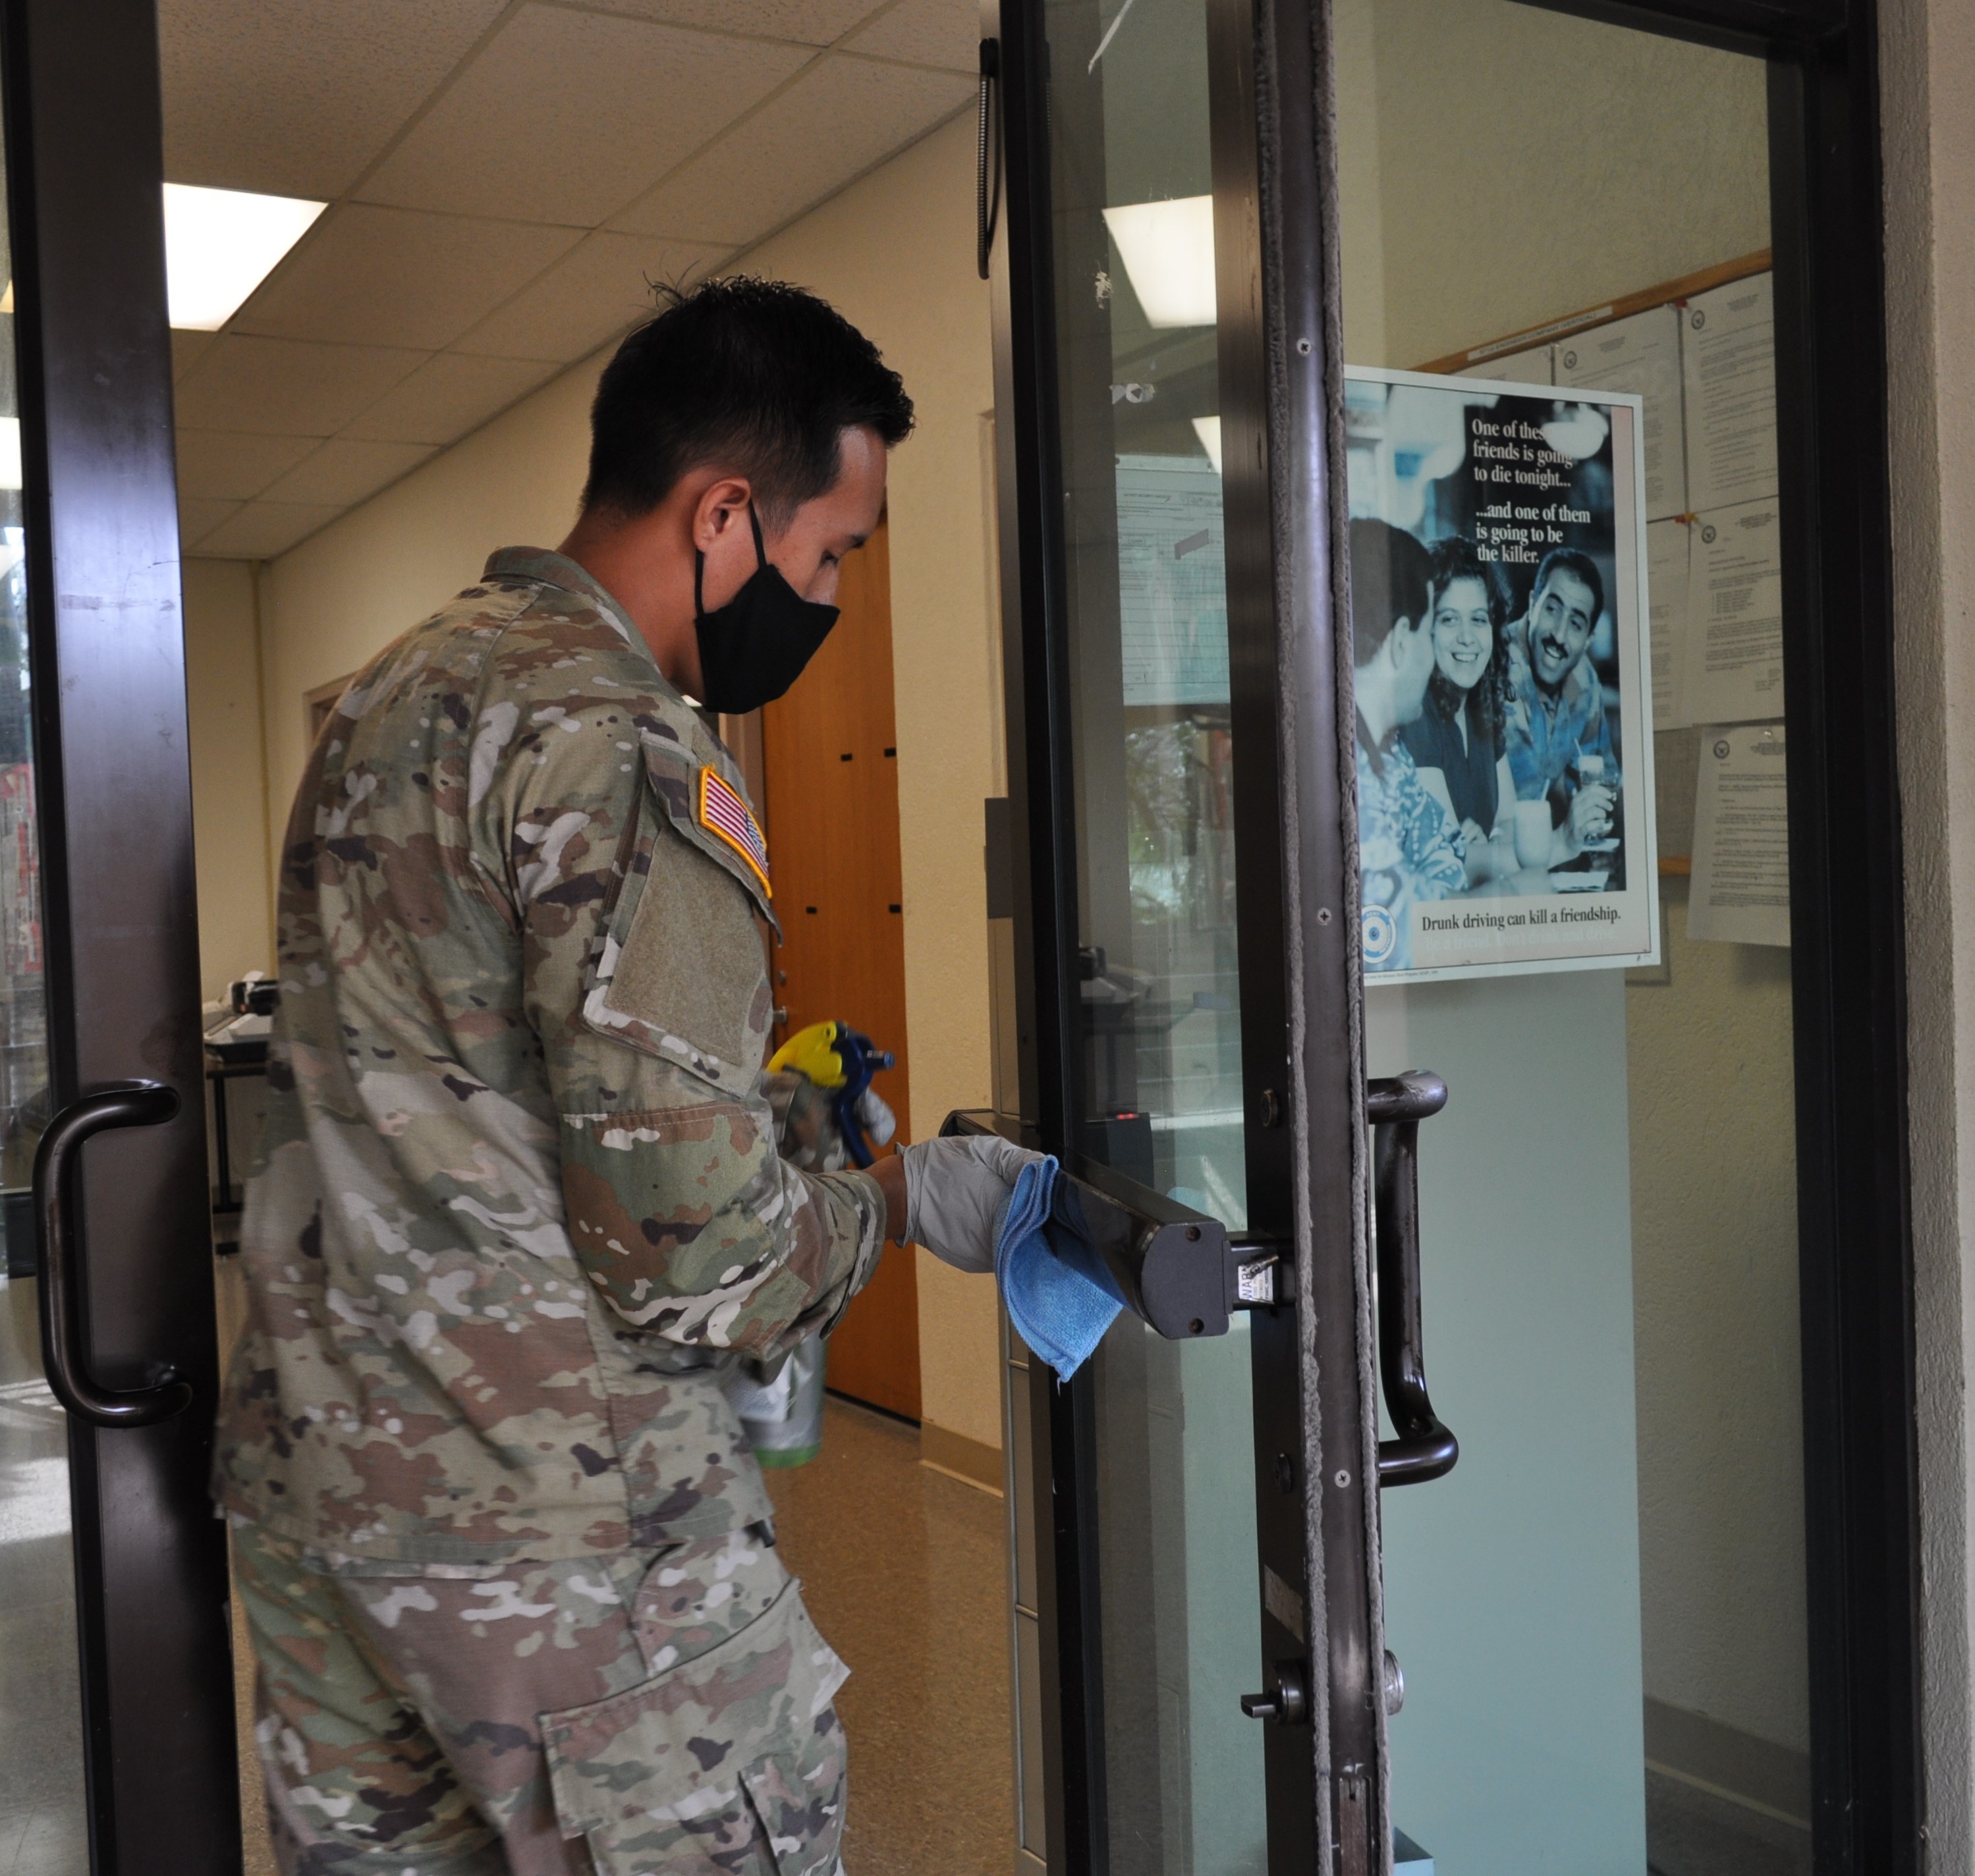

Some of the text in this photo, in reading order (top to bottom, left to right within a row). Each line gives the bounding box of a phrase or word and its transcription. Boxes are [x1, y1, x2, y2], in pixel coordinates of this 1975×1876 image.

[1472, 418, 1544, 440] One of thes
[1473, 439, 1573, 469] friends is going
[1474, 464, 1571, 491] to die tonight...
[1476, 501, 1591, 523] ...and one of them
[1476, 522, 1563, 546] is going to be
[1477, 543, 1540, 563] the killer.
[1422, 906, 1621, 931] Drunk driving can kill a friendship.
